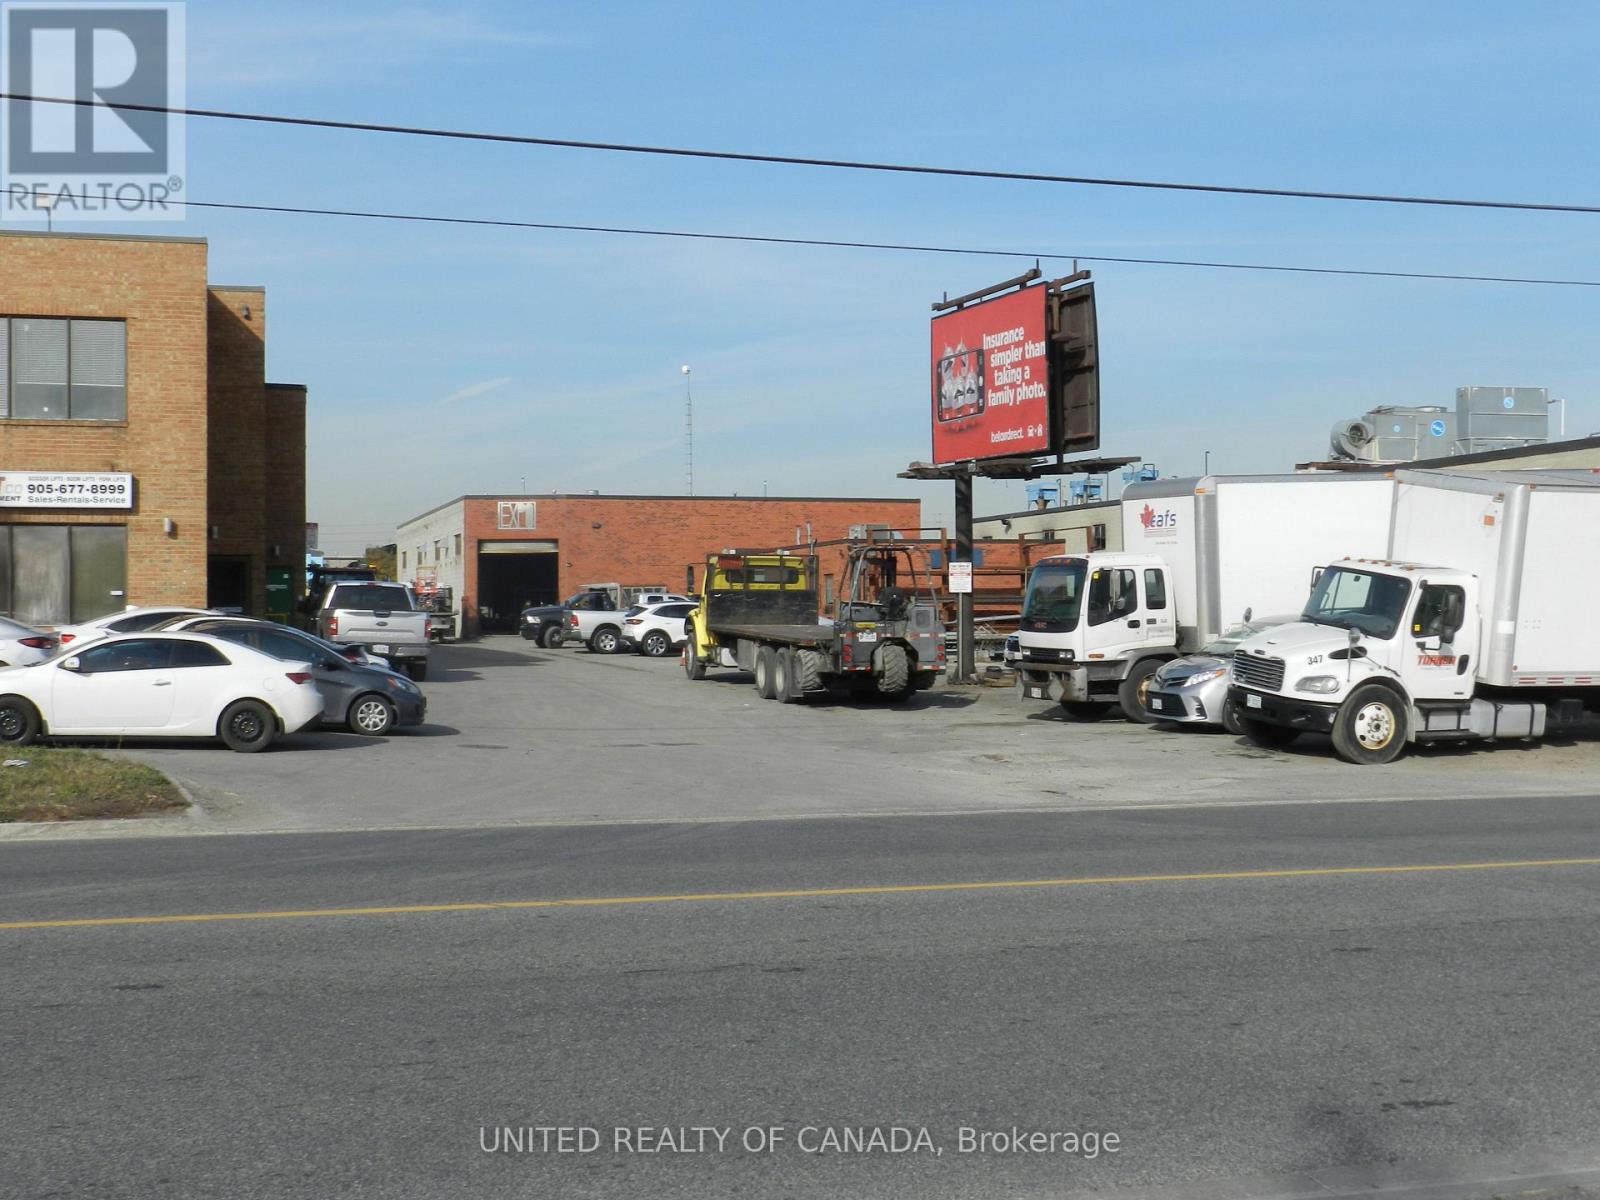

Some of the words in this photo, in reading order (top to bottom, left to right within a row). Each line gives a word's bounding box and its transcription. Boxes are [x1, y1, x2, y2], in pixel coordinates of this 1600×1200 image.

[983, 326, 1025, 350] Insurance
[990, 345, 1023, 368] simpler
[1024, 340, 1046, 359] than
[994, 366, 1022, 386] taking
[1024, 367, 1031, 380] a
[988, 386, 1014, 406] family
[1016, 383, 1046, 404] photo.
[27, 484, 126, 494] 905-677-8999
[27, 495, 127, 504] Sales-Rentals-Service
[1307, 655, 1323, 666] 347
